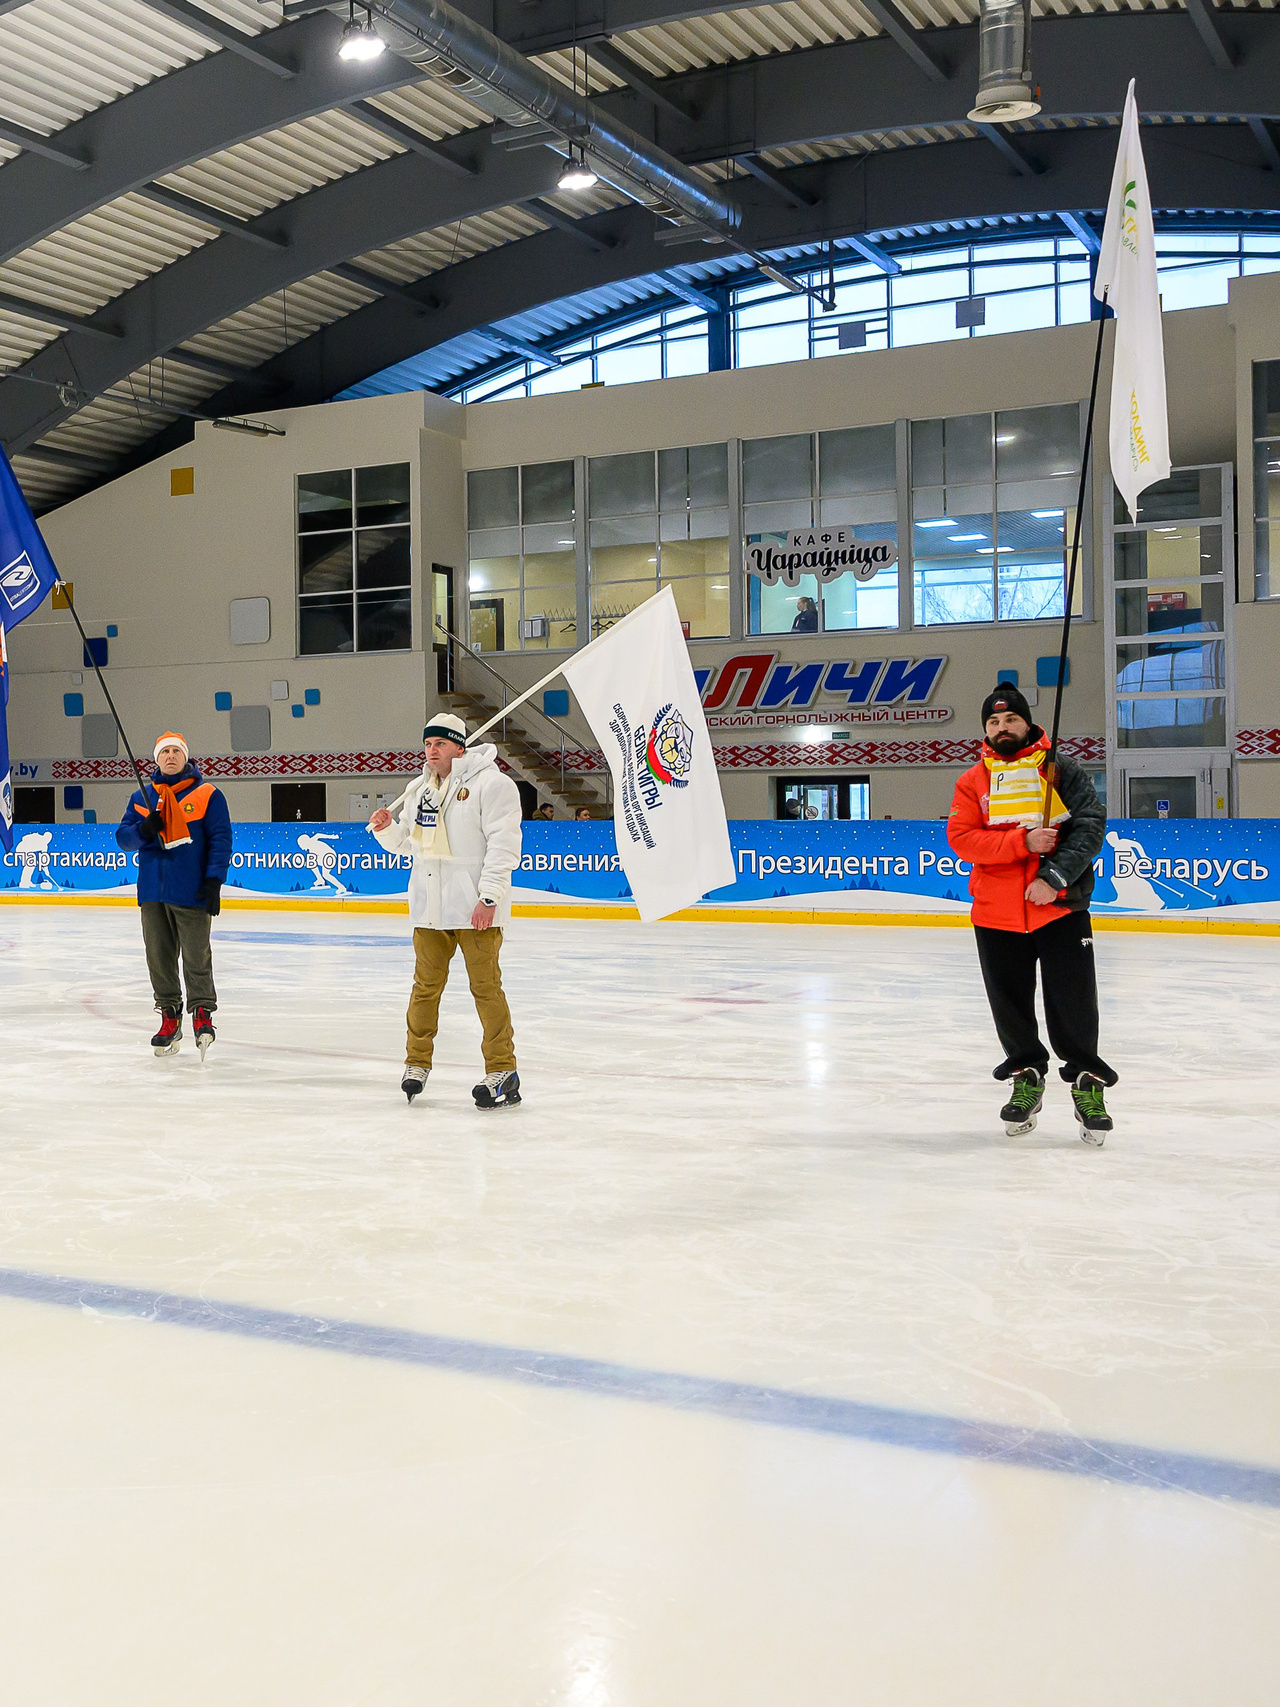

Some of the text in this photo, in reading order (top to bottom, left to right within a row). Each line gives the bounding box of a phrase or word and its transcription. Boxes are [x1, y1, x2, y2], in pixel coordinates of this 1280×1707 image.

[793, 532, 846, 547] КАФЕ
[756, 711, 889, 726] ГОРНОЛЫЖНЫЙ
[893, 709, 949, 724] ЦЕНТР
[612, 703, 631, 734] СБОРНАЯ
[631, 800, 656, 849] ОРГАНИЗАЦИЙ
[634, 725, 663, 810] БЕЛЫЕ ТИГРЫ
[625, 813, 641, 843] ОТДЫХА
[2, 850, 127, 872] спартакиада
[228, 852, 413, 873] отников организ
[738, 849, 910, 880] Президента
[1113, 850, 1269, 886] Беларусь
